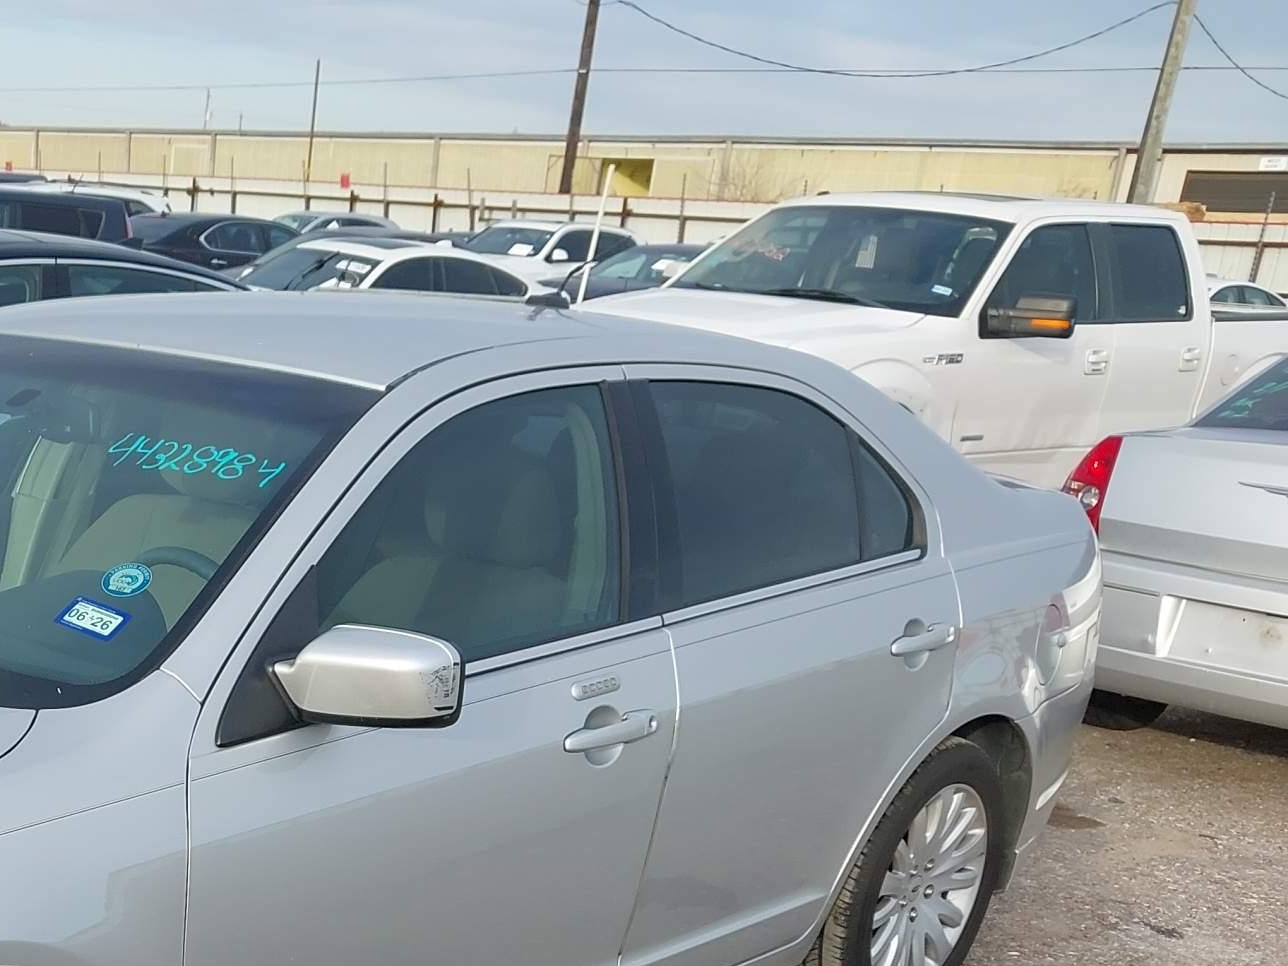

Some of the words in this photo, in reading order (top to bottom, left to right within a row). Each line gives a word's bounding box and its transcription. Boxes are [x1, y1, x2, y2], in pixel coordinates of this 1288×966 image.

[107, 432, 286, 488] 44328984
[68, 607, 89, 621] 06
[90, 616, 113, 631] 26
